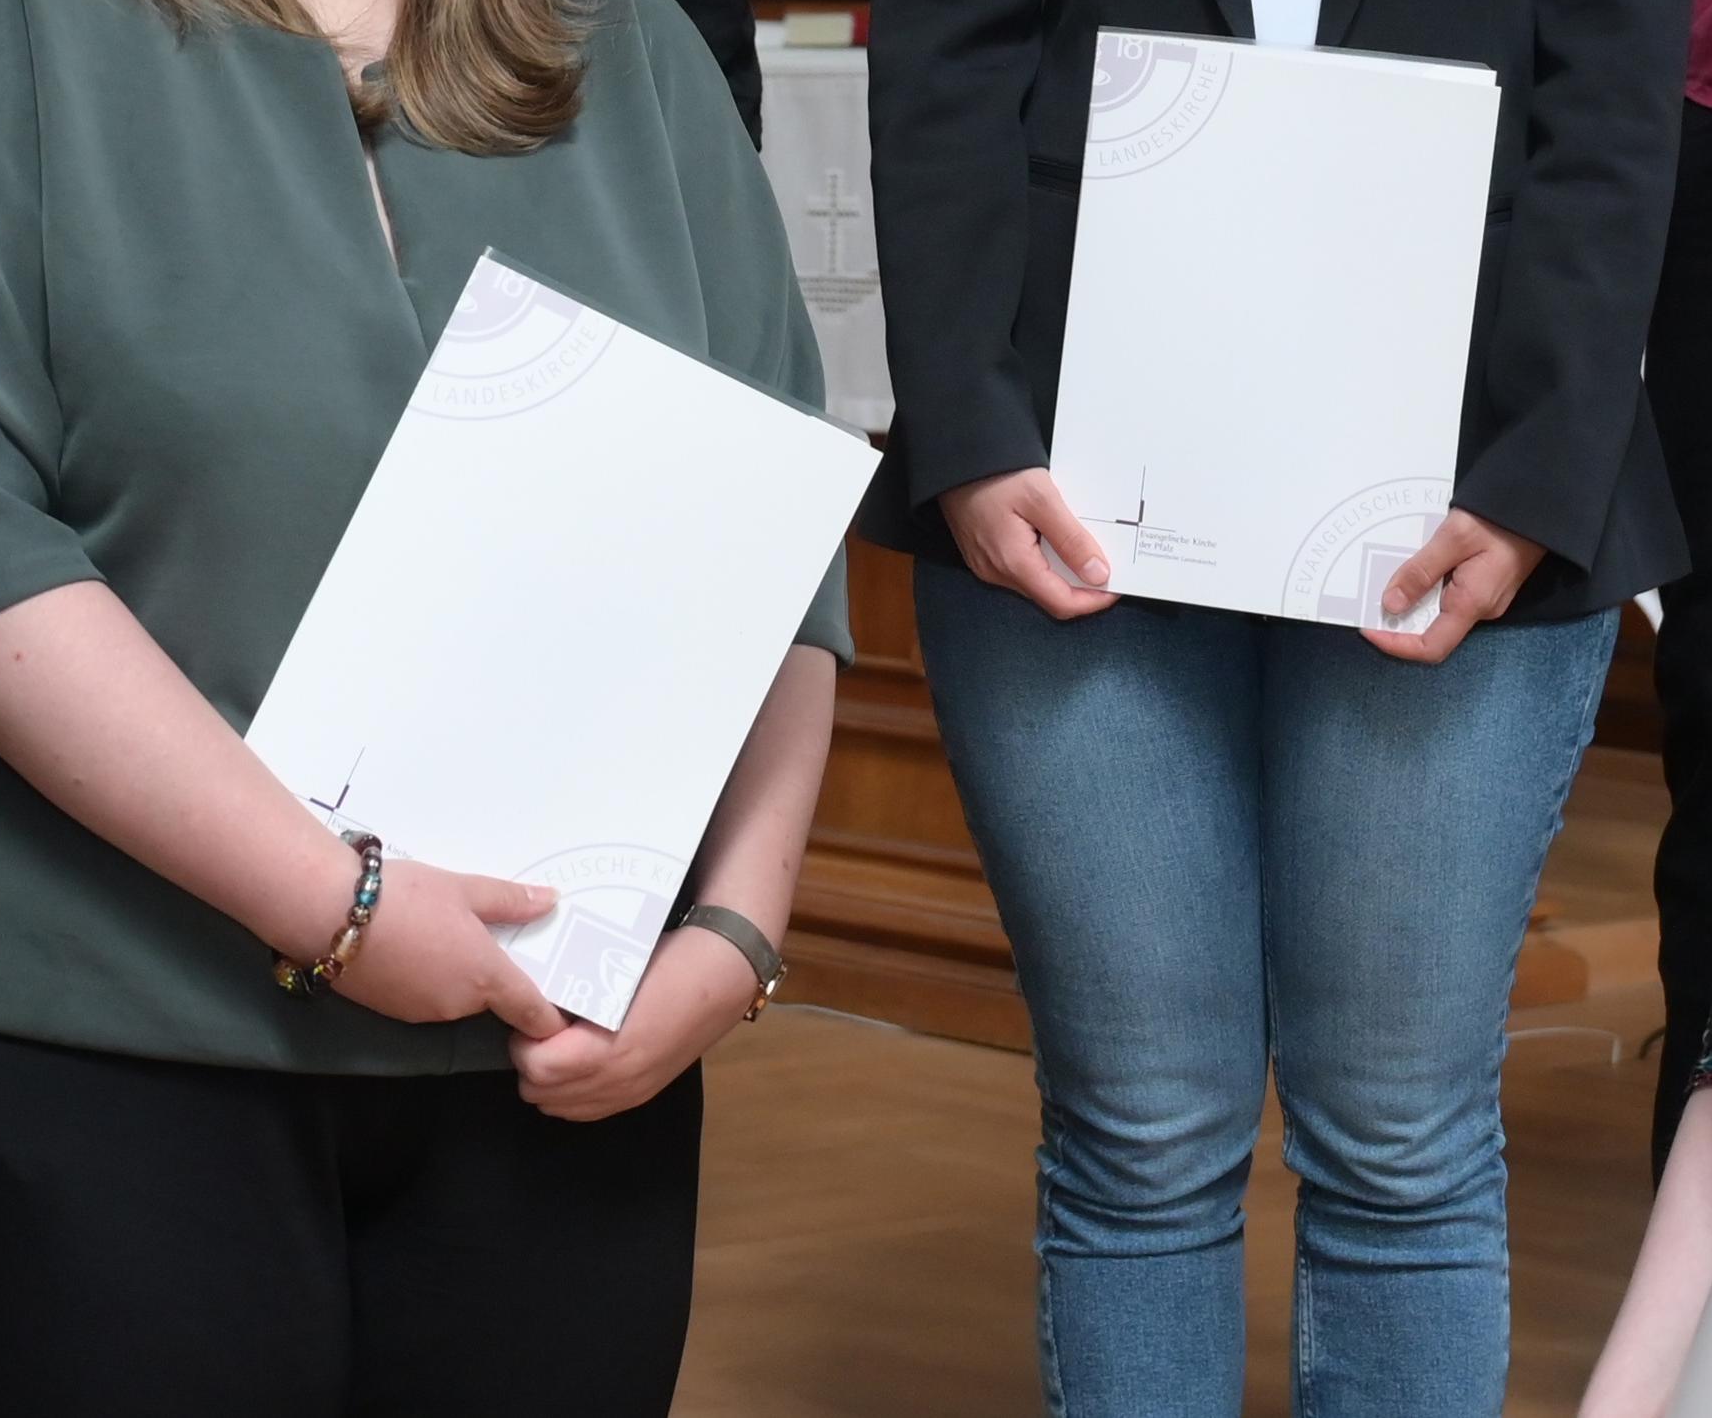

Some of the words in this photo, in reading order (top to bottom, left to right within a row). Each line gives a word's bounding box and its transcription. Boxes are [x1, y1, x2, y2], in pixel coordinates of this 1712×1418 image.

[1098, 62, 1219, 167] LANDESKIRCHE
[432, 325, 600, 406] LANDESKIRCHE
[1139, 528, 1190, 545] Evangelische
[1192, 534, 1218, 549] Kirche
[1294, 487, 1412, 596] EVANGELISCHE
